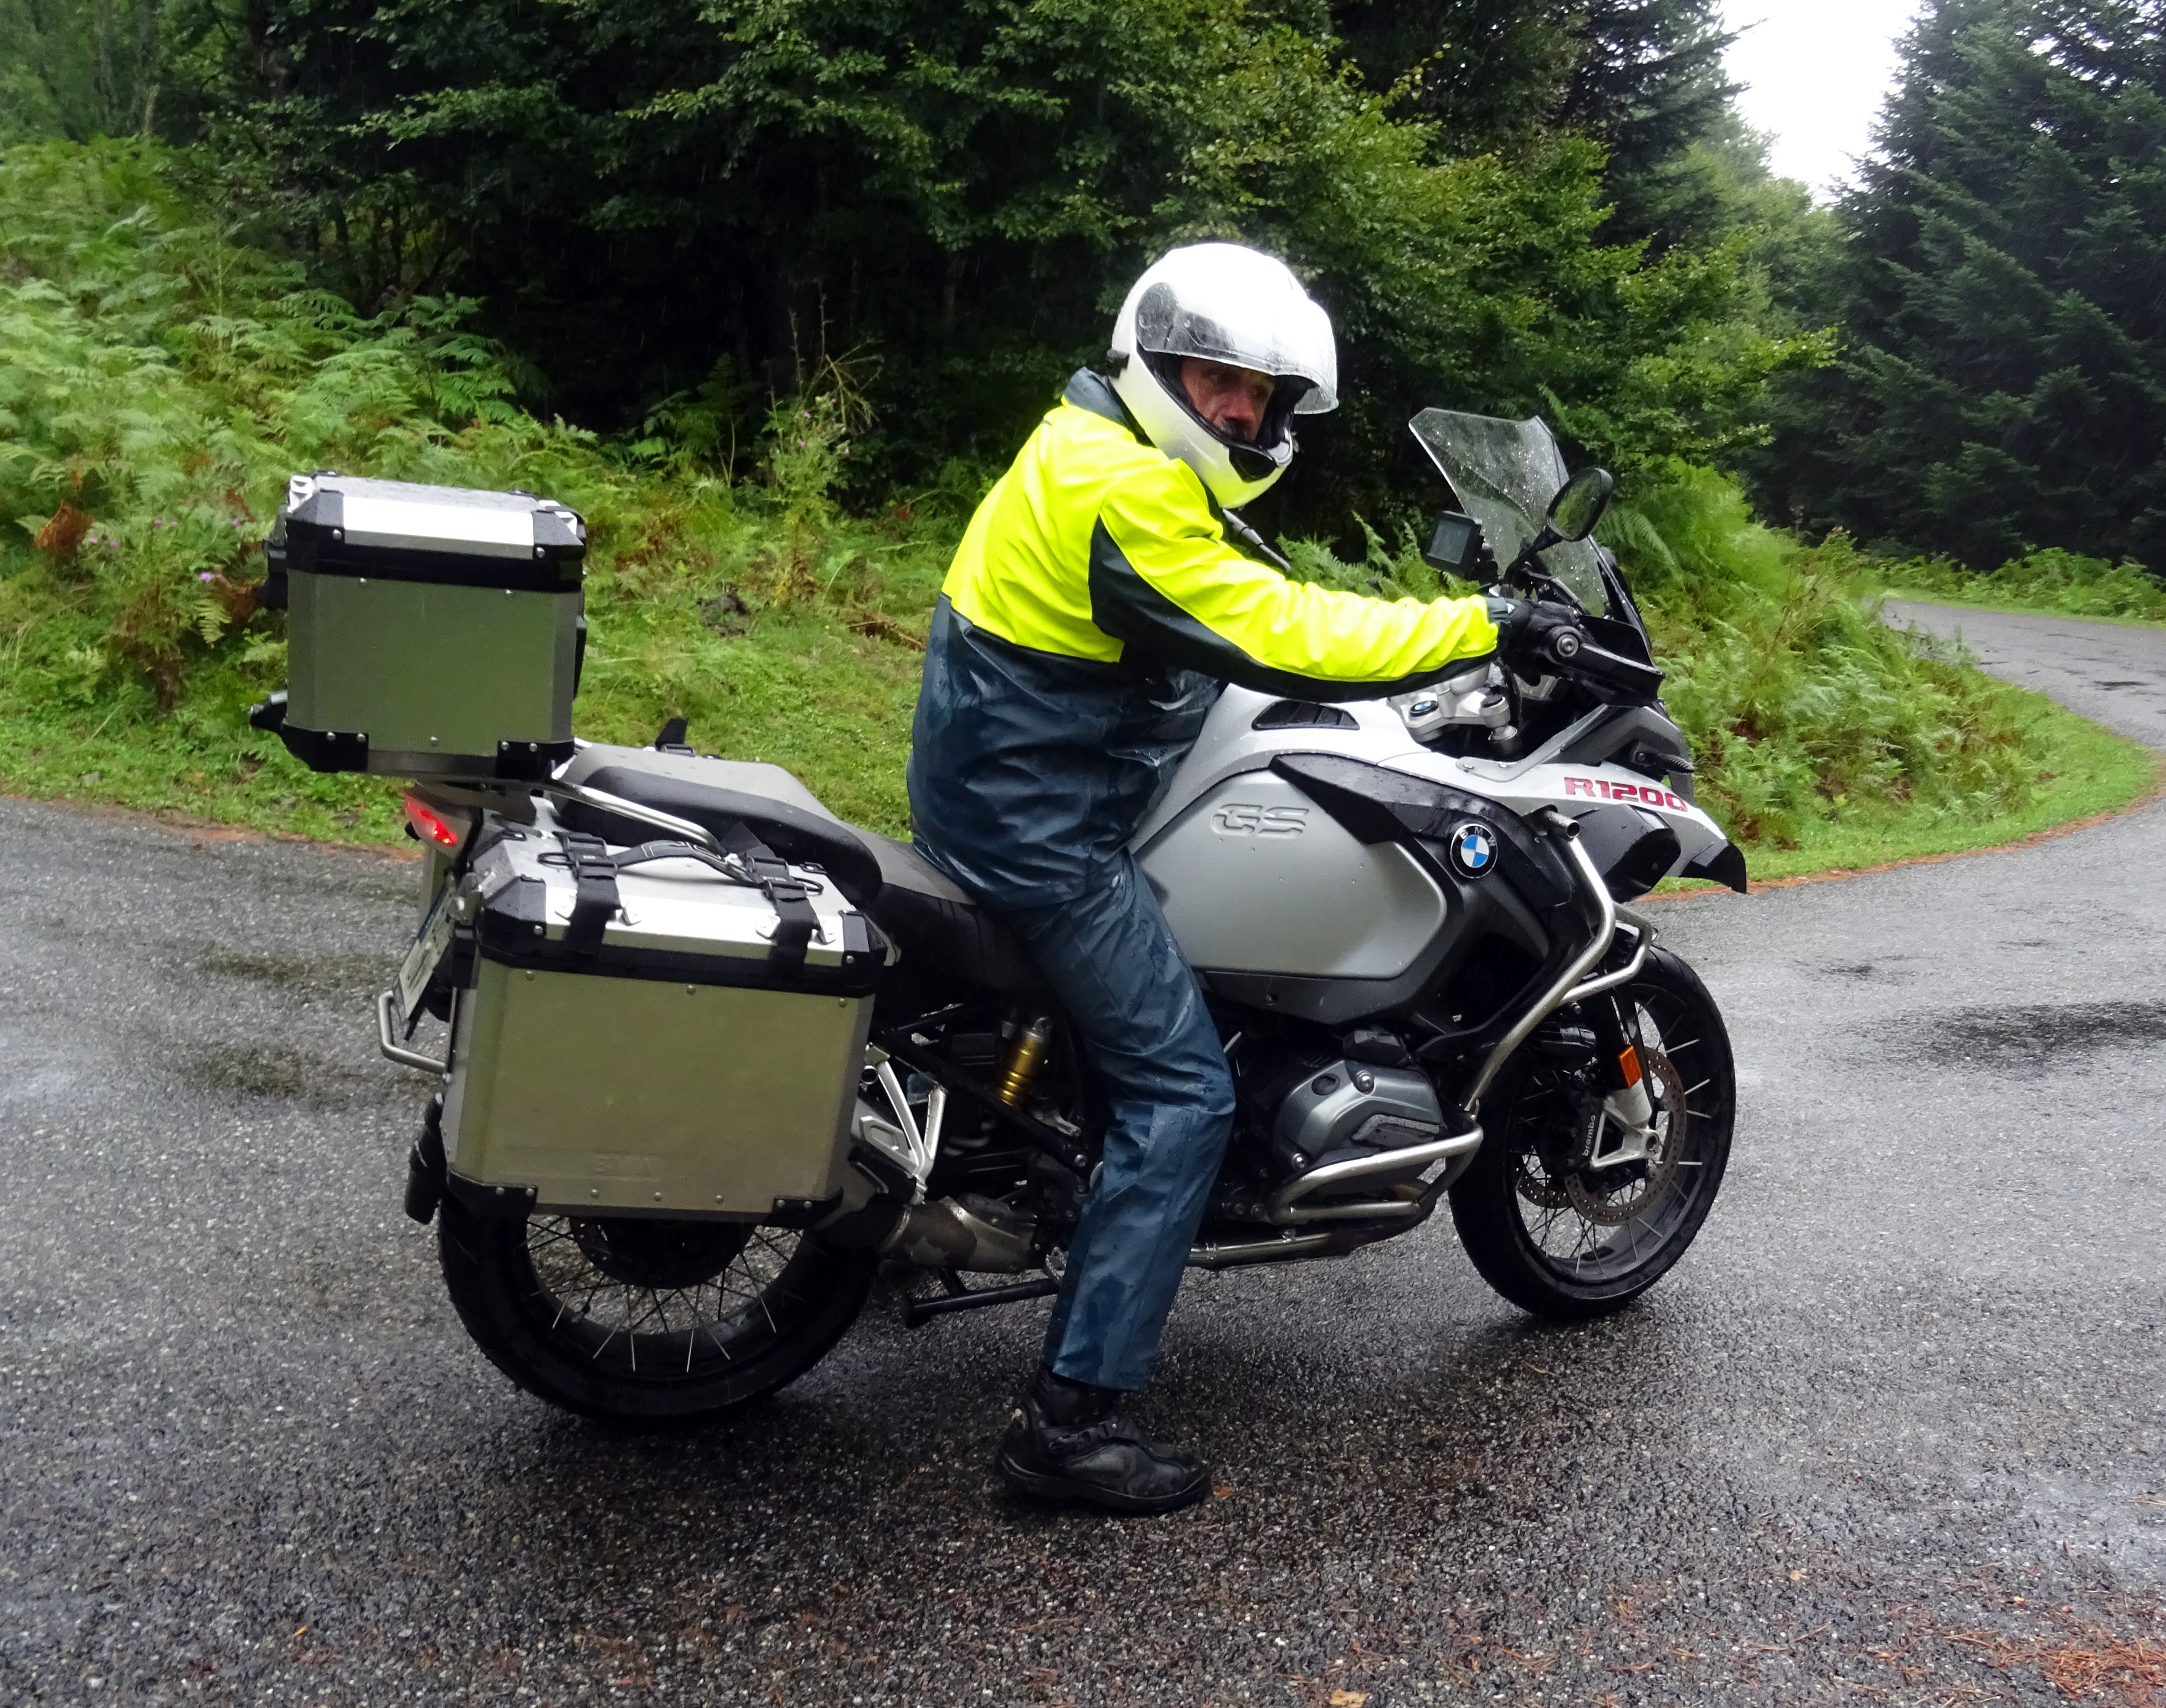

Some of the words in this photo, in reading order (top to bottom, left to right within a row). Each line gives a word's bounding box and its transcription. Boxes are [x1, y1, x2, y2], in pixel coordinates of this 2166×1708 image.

[1563, 776, 1688, 812] R1200
[1211, 803, 1310, 839] GS
[1459, 826, 1496, 847] BMW
[1582, 1114, 1596, 1156] brembo
